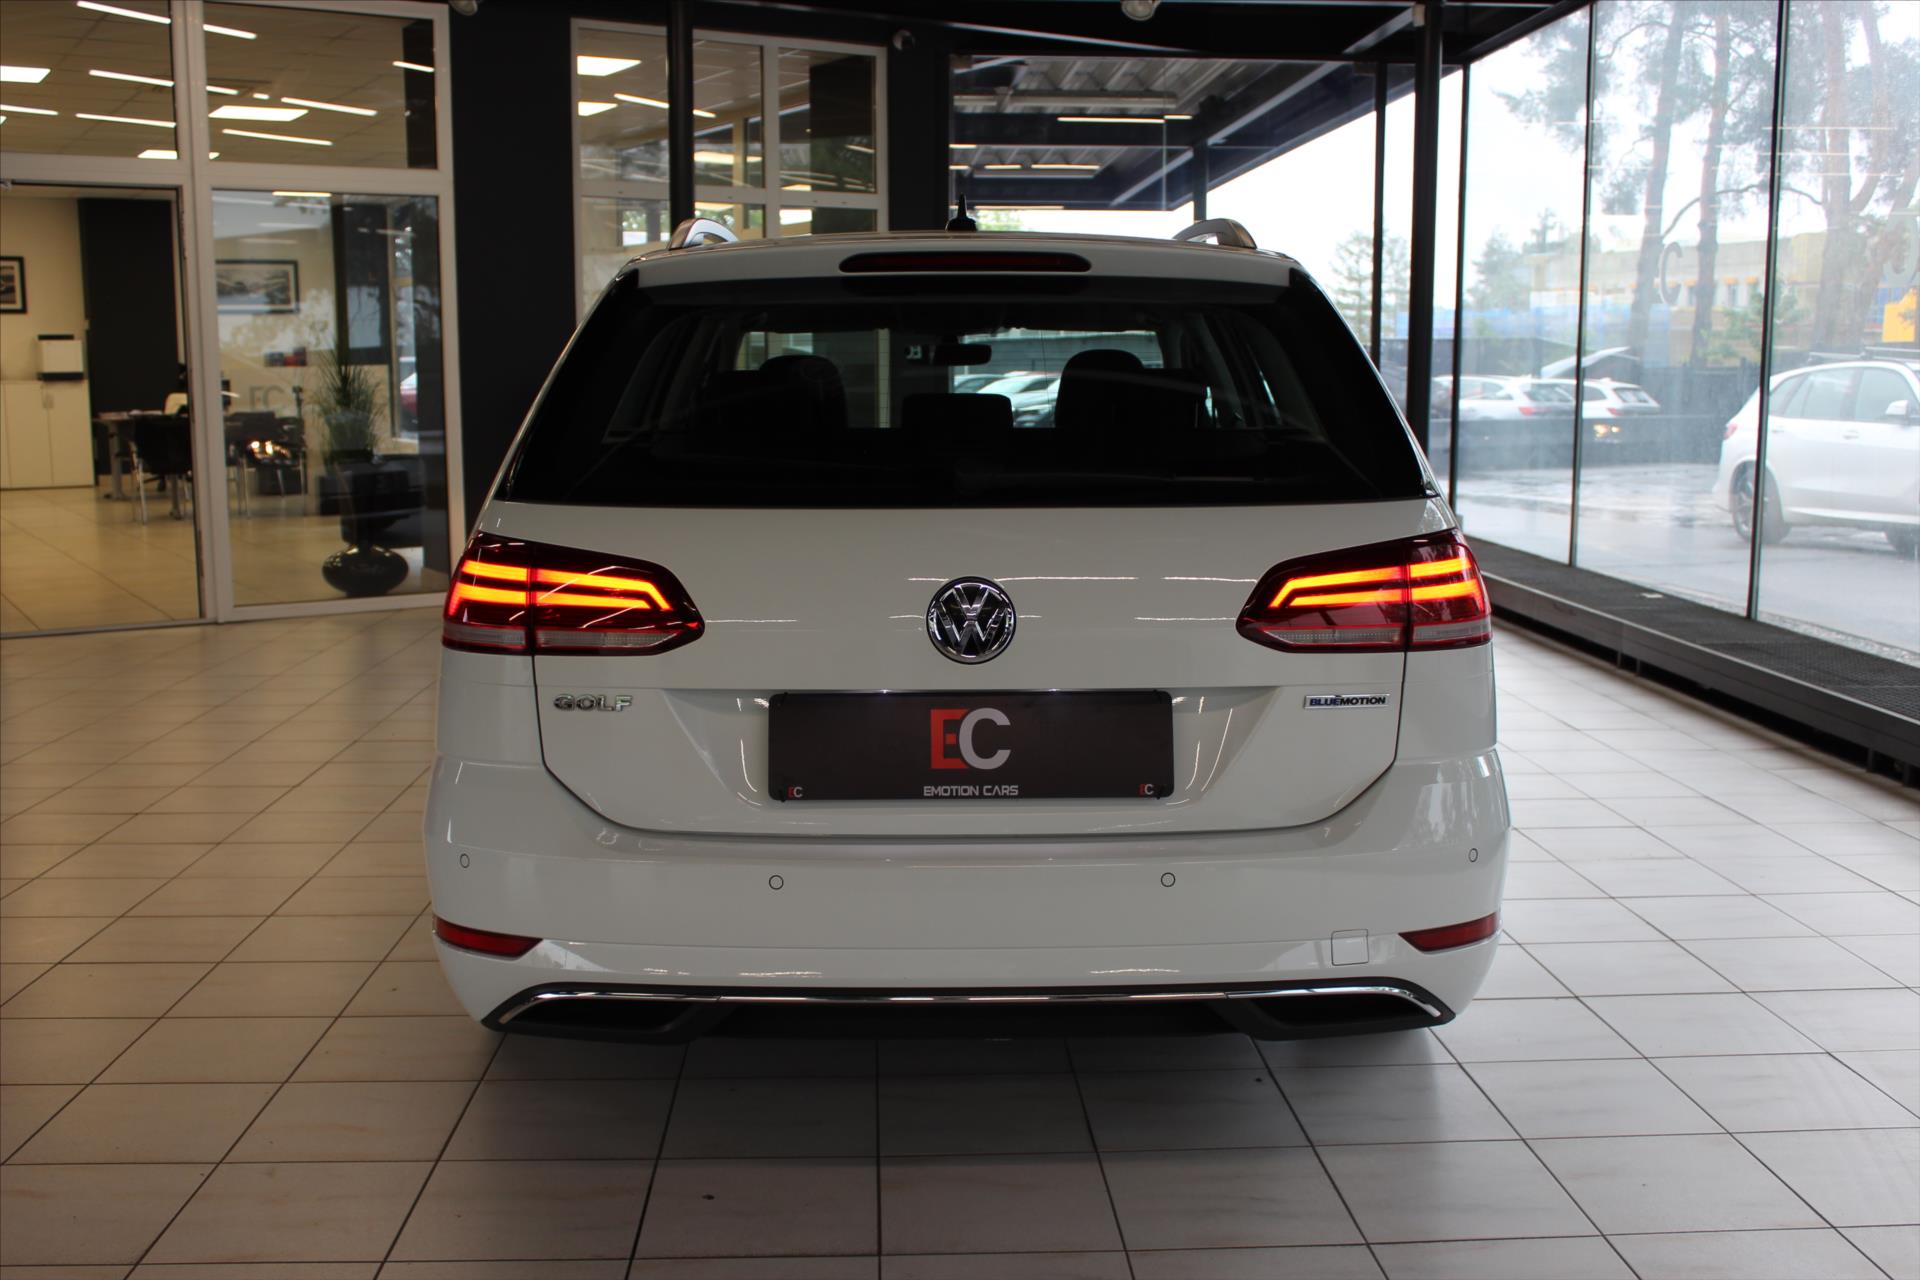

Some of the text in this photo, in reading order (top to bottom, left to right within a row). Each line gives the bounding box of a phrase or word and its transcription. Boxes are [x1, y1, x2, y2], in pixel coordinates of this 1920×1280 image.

[554, 694, 632, 711] GOLF
[1309, 697, 1386, 706] BLUEMOTION
[930, 707, 1011, 770] EC
[923, 785, 1019, 796] EMOTION CARS
